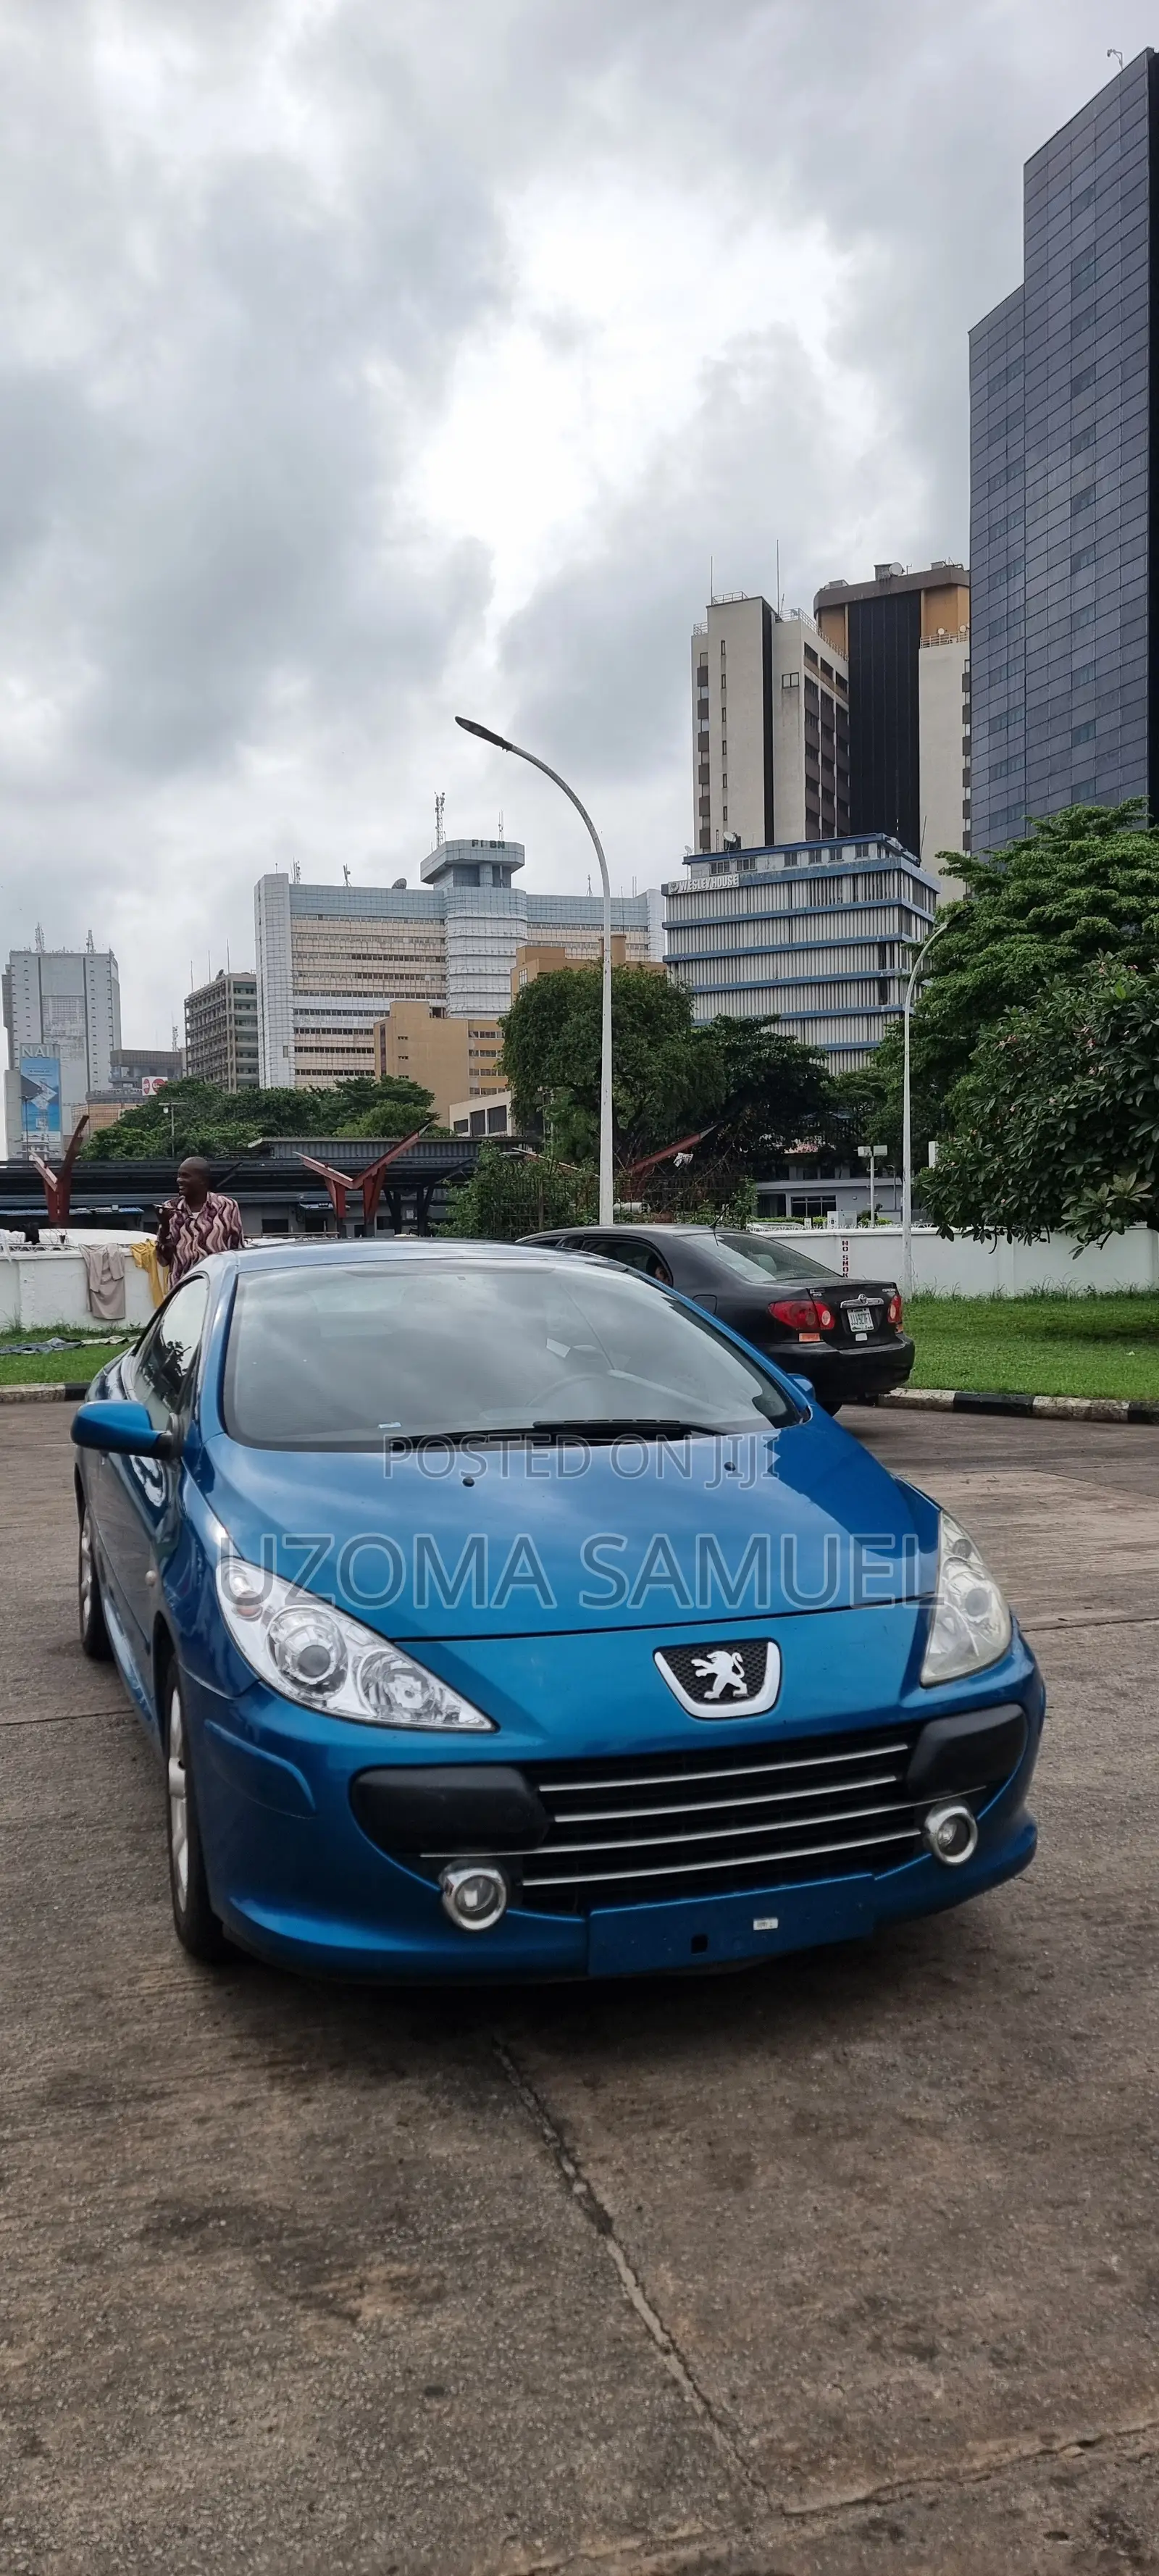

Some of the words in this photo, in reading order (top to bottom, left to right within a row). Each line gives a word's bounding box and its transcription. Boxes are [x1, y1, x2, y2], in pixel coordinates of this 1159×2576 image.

[681, 877, 711, 892] WESLEY
[711, 874, 738, 889] HOUSE
[842, 1240, 848, 1252] NO
